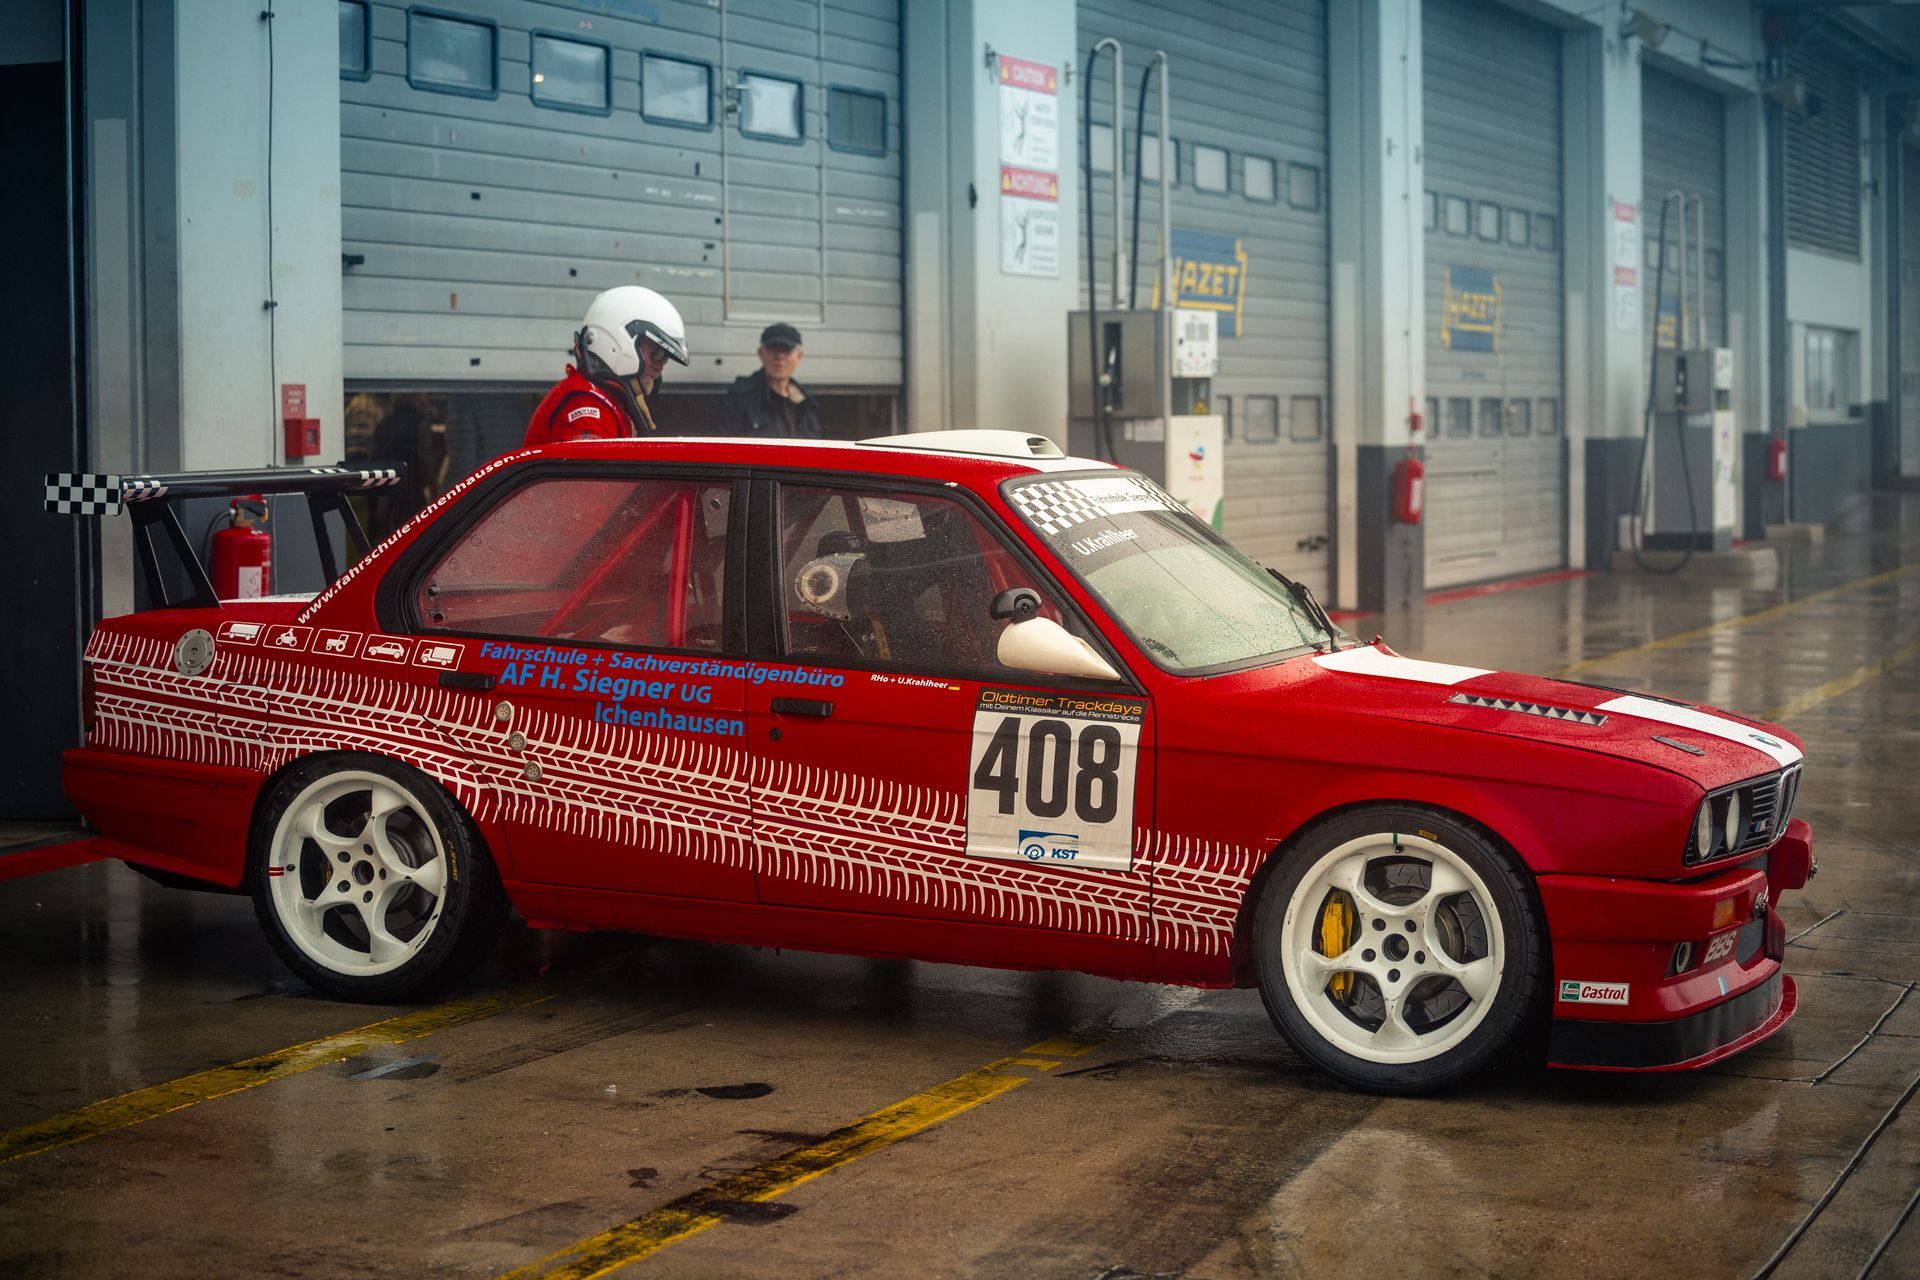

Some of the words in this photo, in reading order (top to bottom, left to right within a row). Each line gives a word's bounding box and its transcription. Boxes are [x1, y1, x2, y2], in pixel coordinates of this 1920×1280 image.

[1071, 529, 1139, 555] U.Krahlheer
[480, 642, 588, 665] Fahrschule
[592, 654, 605, 665] +
[608, 652, 845, 687] Sachverständigenbüro
[499, 662, 536, 686] AF
[540, 665, 566, 690] H.
[572, 669, 675, 700] Siegner
[680, 683, 712, 704] UG
[870, 674, 889, 683] RHo
[897, 677, 948, 689] U.Krahlheer
[980, 702, 993, 710] mit
[994, 703, 1025, 712] Deinem
[1024, 706, 1061, 715] Klassiker
[1061, 709, 1075, 717] auf
[1075, 710, 1087, 718] die
[1087, 711, 1140, 722] Rennstrecke
[982, 690, 1054, 707] Oldtimer
[1057, 697, 1143, 715] Trackdays
[595, 701, 744, 736] Ichenhausen
[974, 717, 1121, 824] 408
[1051, 848, 1079, 860] KST
[1703, 930, 1738, 964] BBS
[1581, 986, 1626, 1000] Castrol
